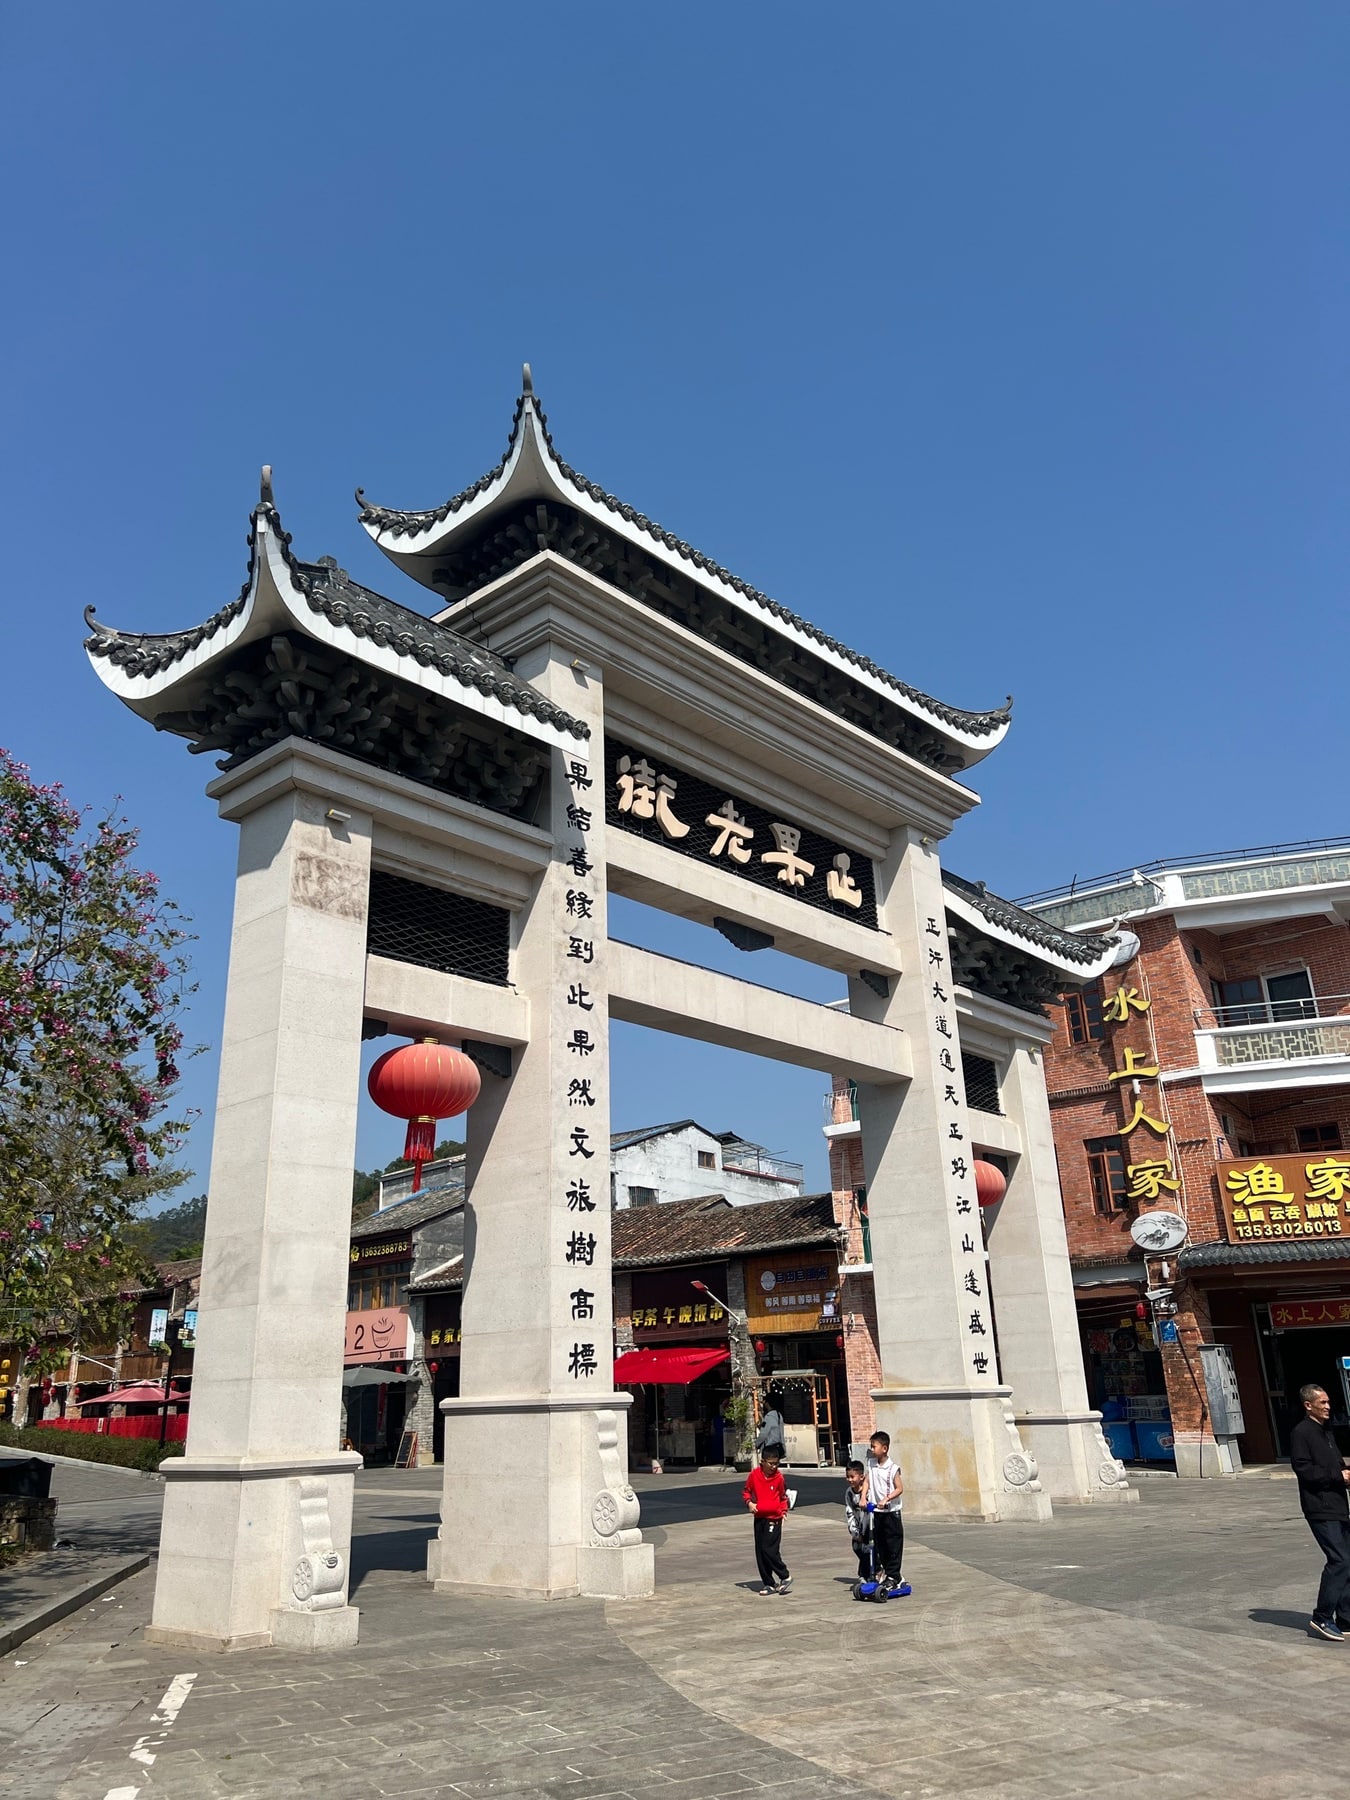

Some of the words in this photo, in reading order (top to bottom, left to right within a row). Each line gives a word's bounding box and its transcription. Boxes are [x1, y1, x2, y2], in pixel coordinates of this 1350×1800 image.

[1103, 986, 1182, 1199] 水上人家
[1226, 1157, 1350, 1205] 渔家
[1232, 1207, 1265, 1223] 鱼面
[1269, 1205, 1301, 1220] 云吞
[1236, 1220, 1342, 1238] 13533026013
[1276, 1303, 1350, 1324] 水上人家
